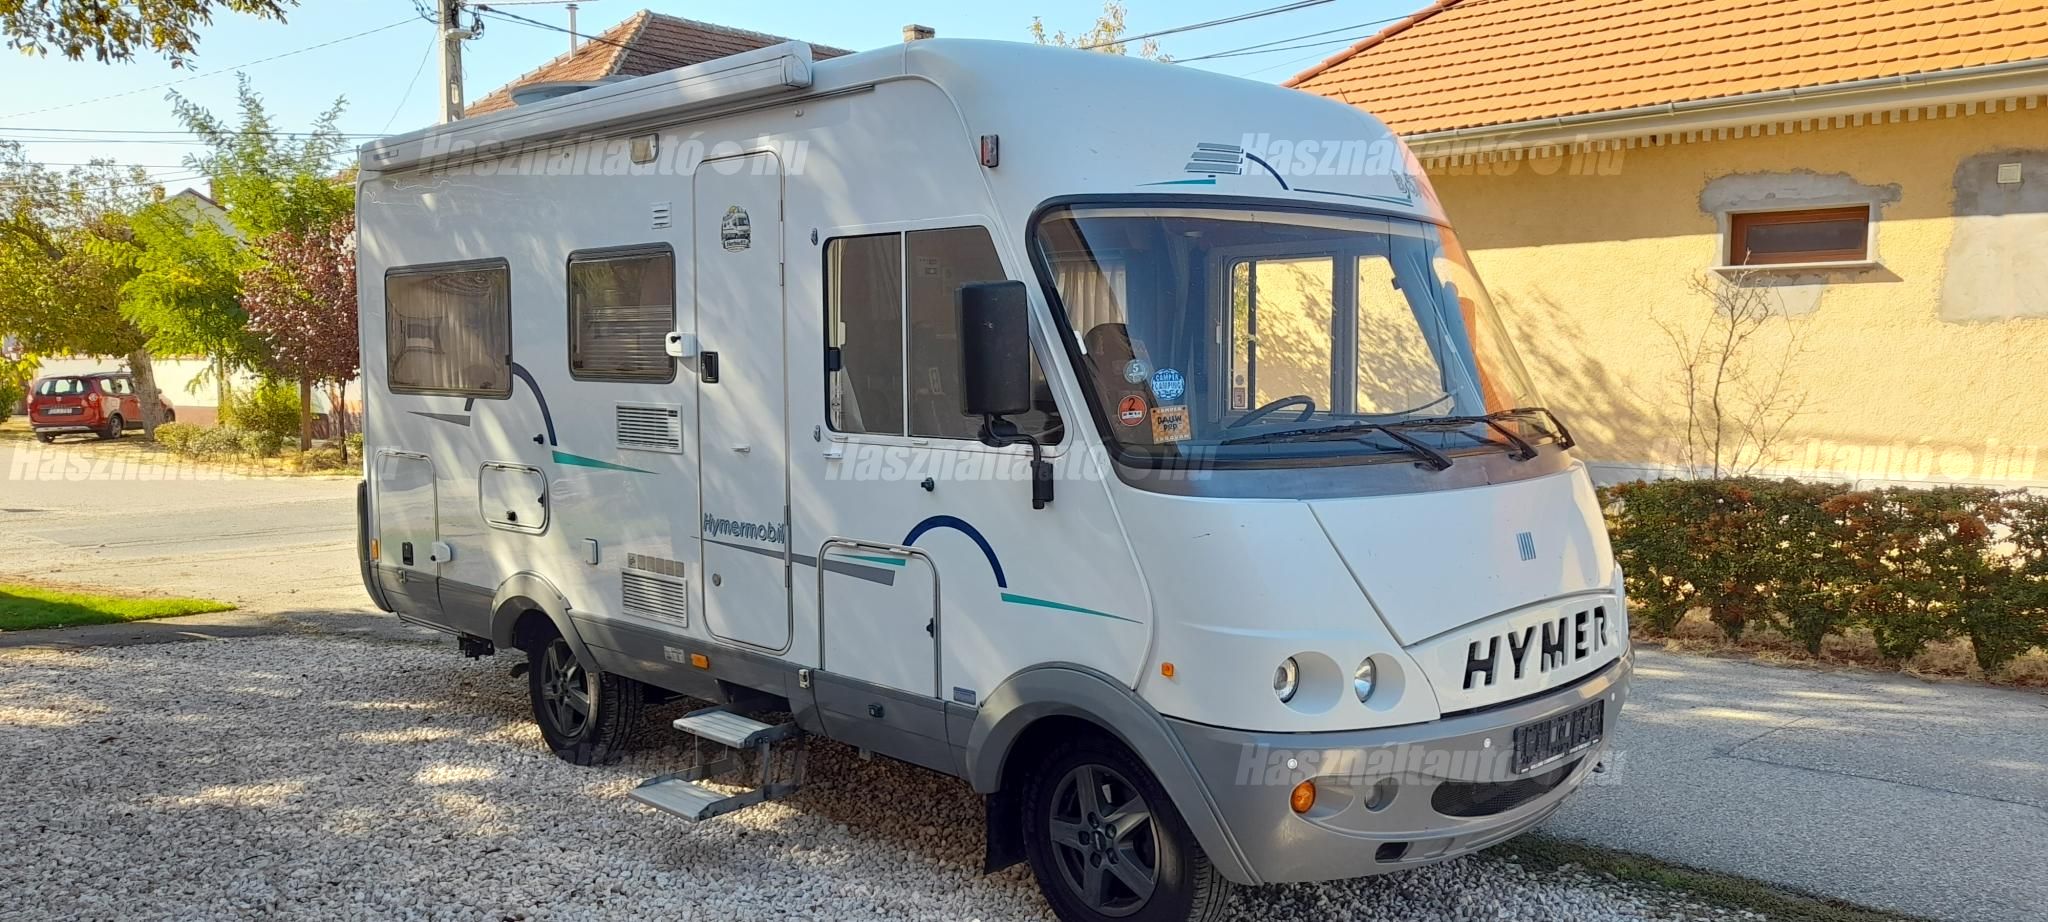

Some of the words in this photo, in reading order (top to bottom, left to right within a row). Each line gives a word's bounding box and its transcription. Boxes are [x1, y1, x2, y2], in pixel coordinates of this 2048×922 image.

[1128, 397, 1136, 411] 2
[703, 512, 785, 544] Hymermobil
[1462, 605, 1608, 690] HYMER
